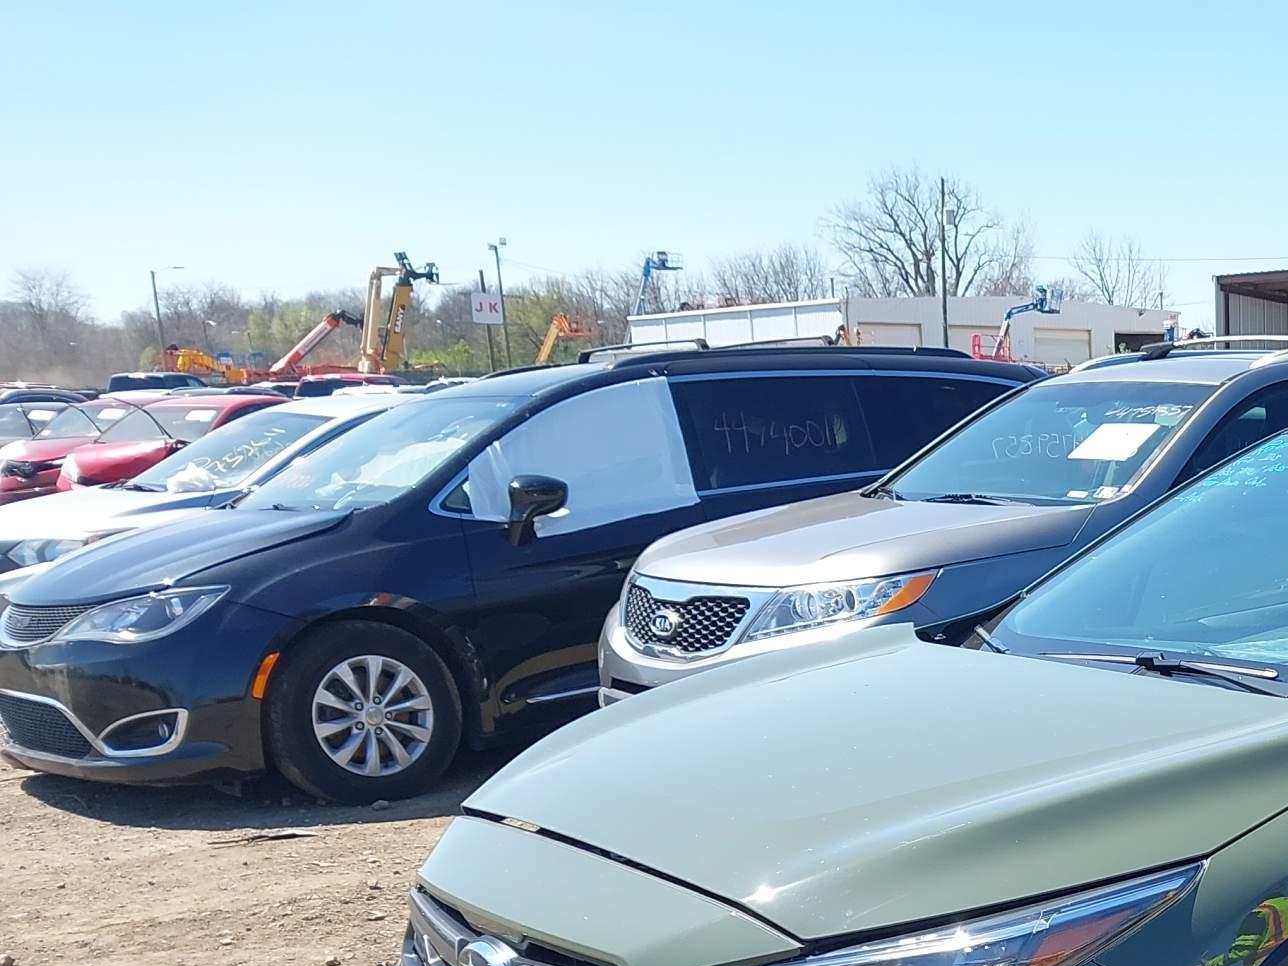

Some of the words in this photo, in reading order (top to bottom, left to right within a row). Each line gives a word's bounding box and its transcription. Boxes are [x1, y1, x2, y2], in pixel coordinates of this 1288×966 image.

[474, 301, 484, 313] J
[488, 302, 499, 314] K
[654, 616, 671, 631] KIA
